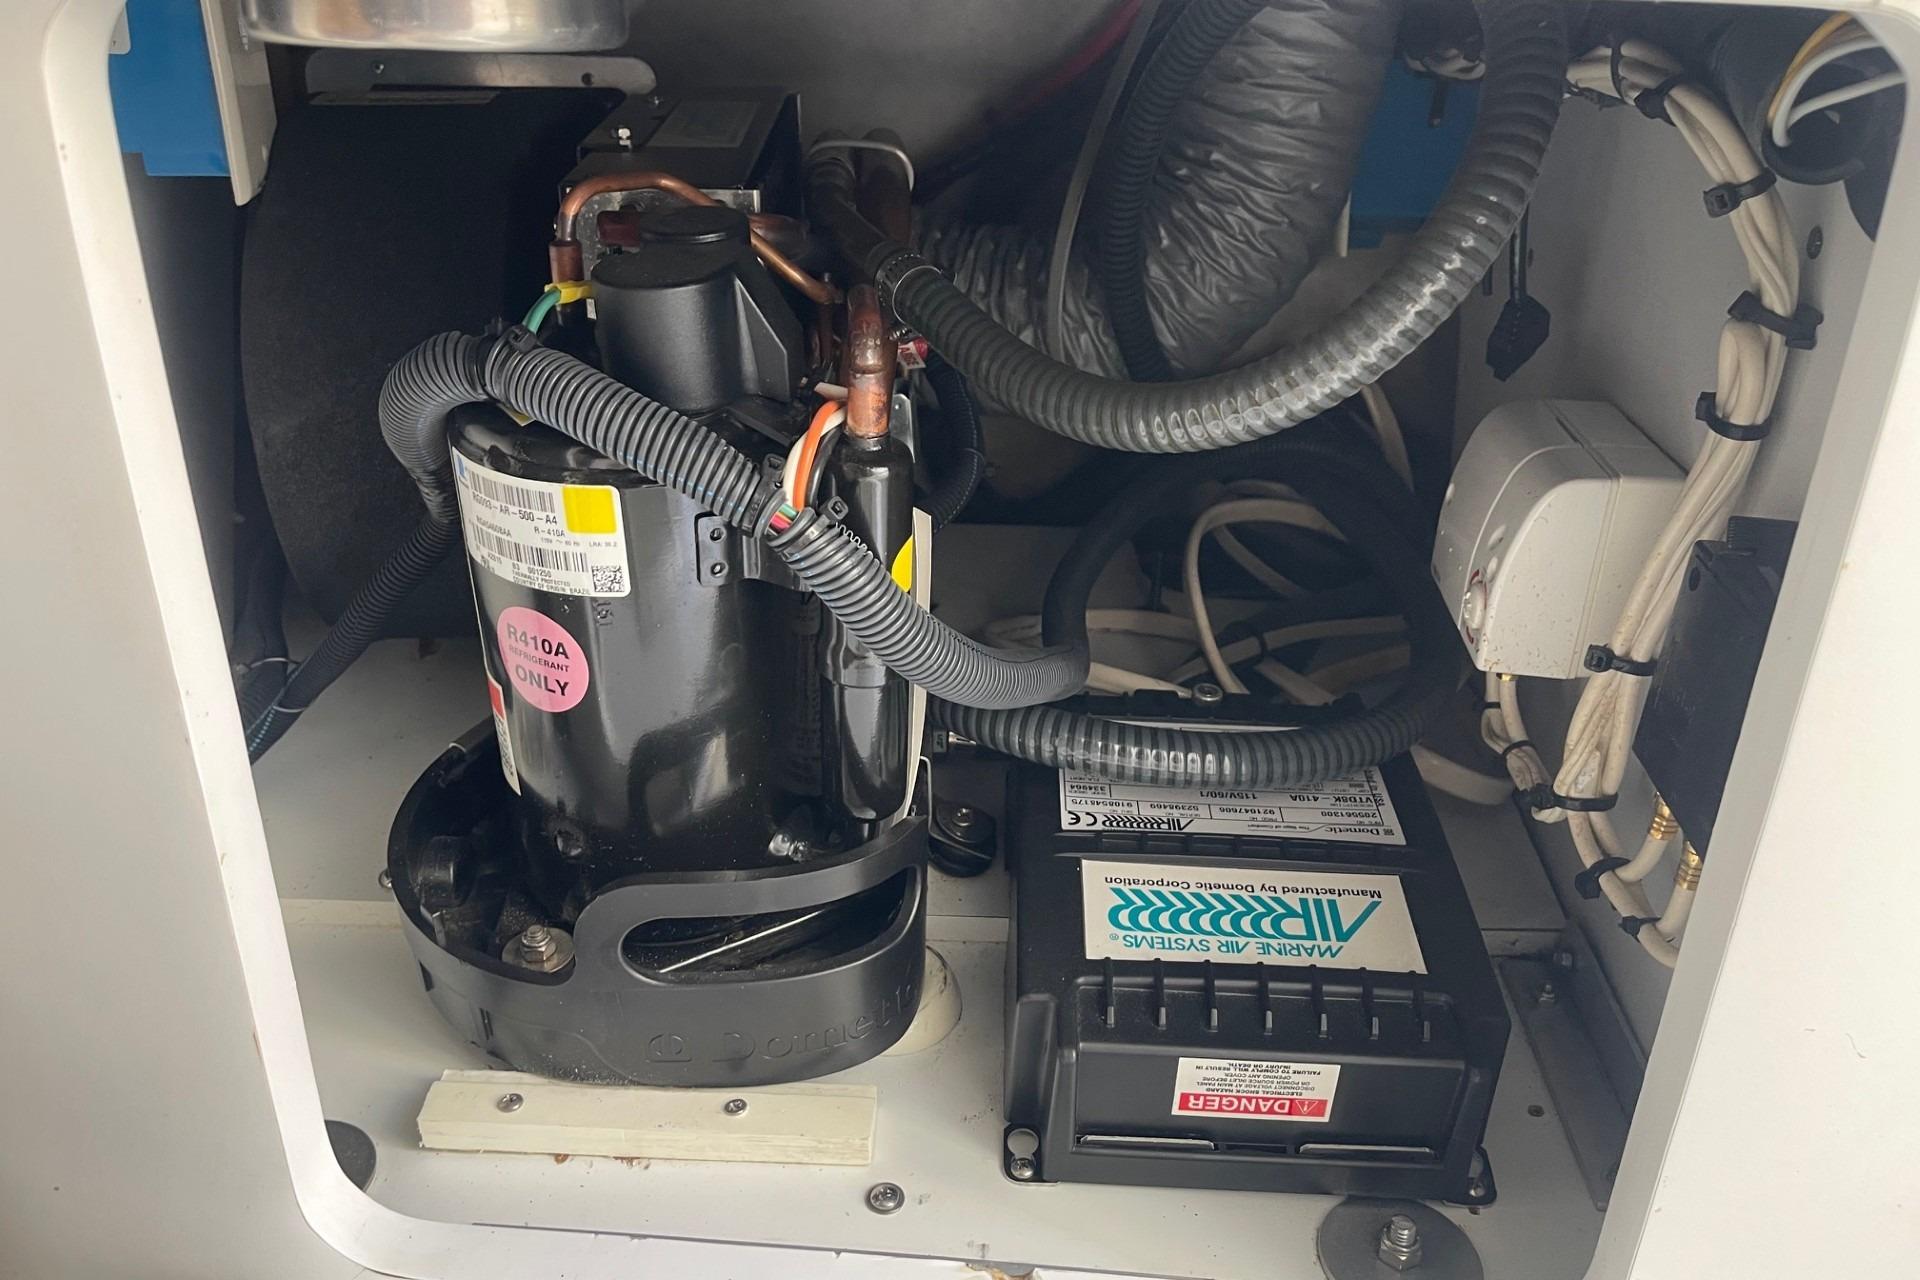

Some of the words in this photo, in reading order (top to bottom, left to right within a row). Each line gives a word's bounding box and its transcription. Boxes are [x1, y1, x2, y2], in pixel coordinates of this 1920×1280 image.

[507, 623, 569, 660] R410A
[508, 643, 569, 673] REFRIGERANT
[515, 664, 569, 697] ONLY
[1199, 790, 1259, 799] 115V/60/1
[1325, 827, 1380, 836] Dometic
[1105, 876, 1191, 890] Corporation
[1195, 881, 1255, 893] Dometic
[1260, 883, 1277, 896] by
[1281, 885, 1383, 900] Manufactured
[1217, 939, 1251, 955] AIR
[1256, 941, 1344, 959] MARINE
[1188, 1095, 1291, 1114] DANGER
